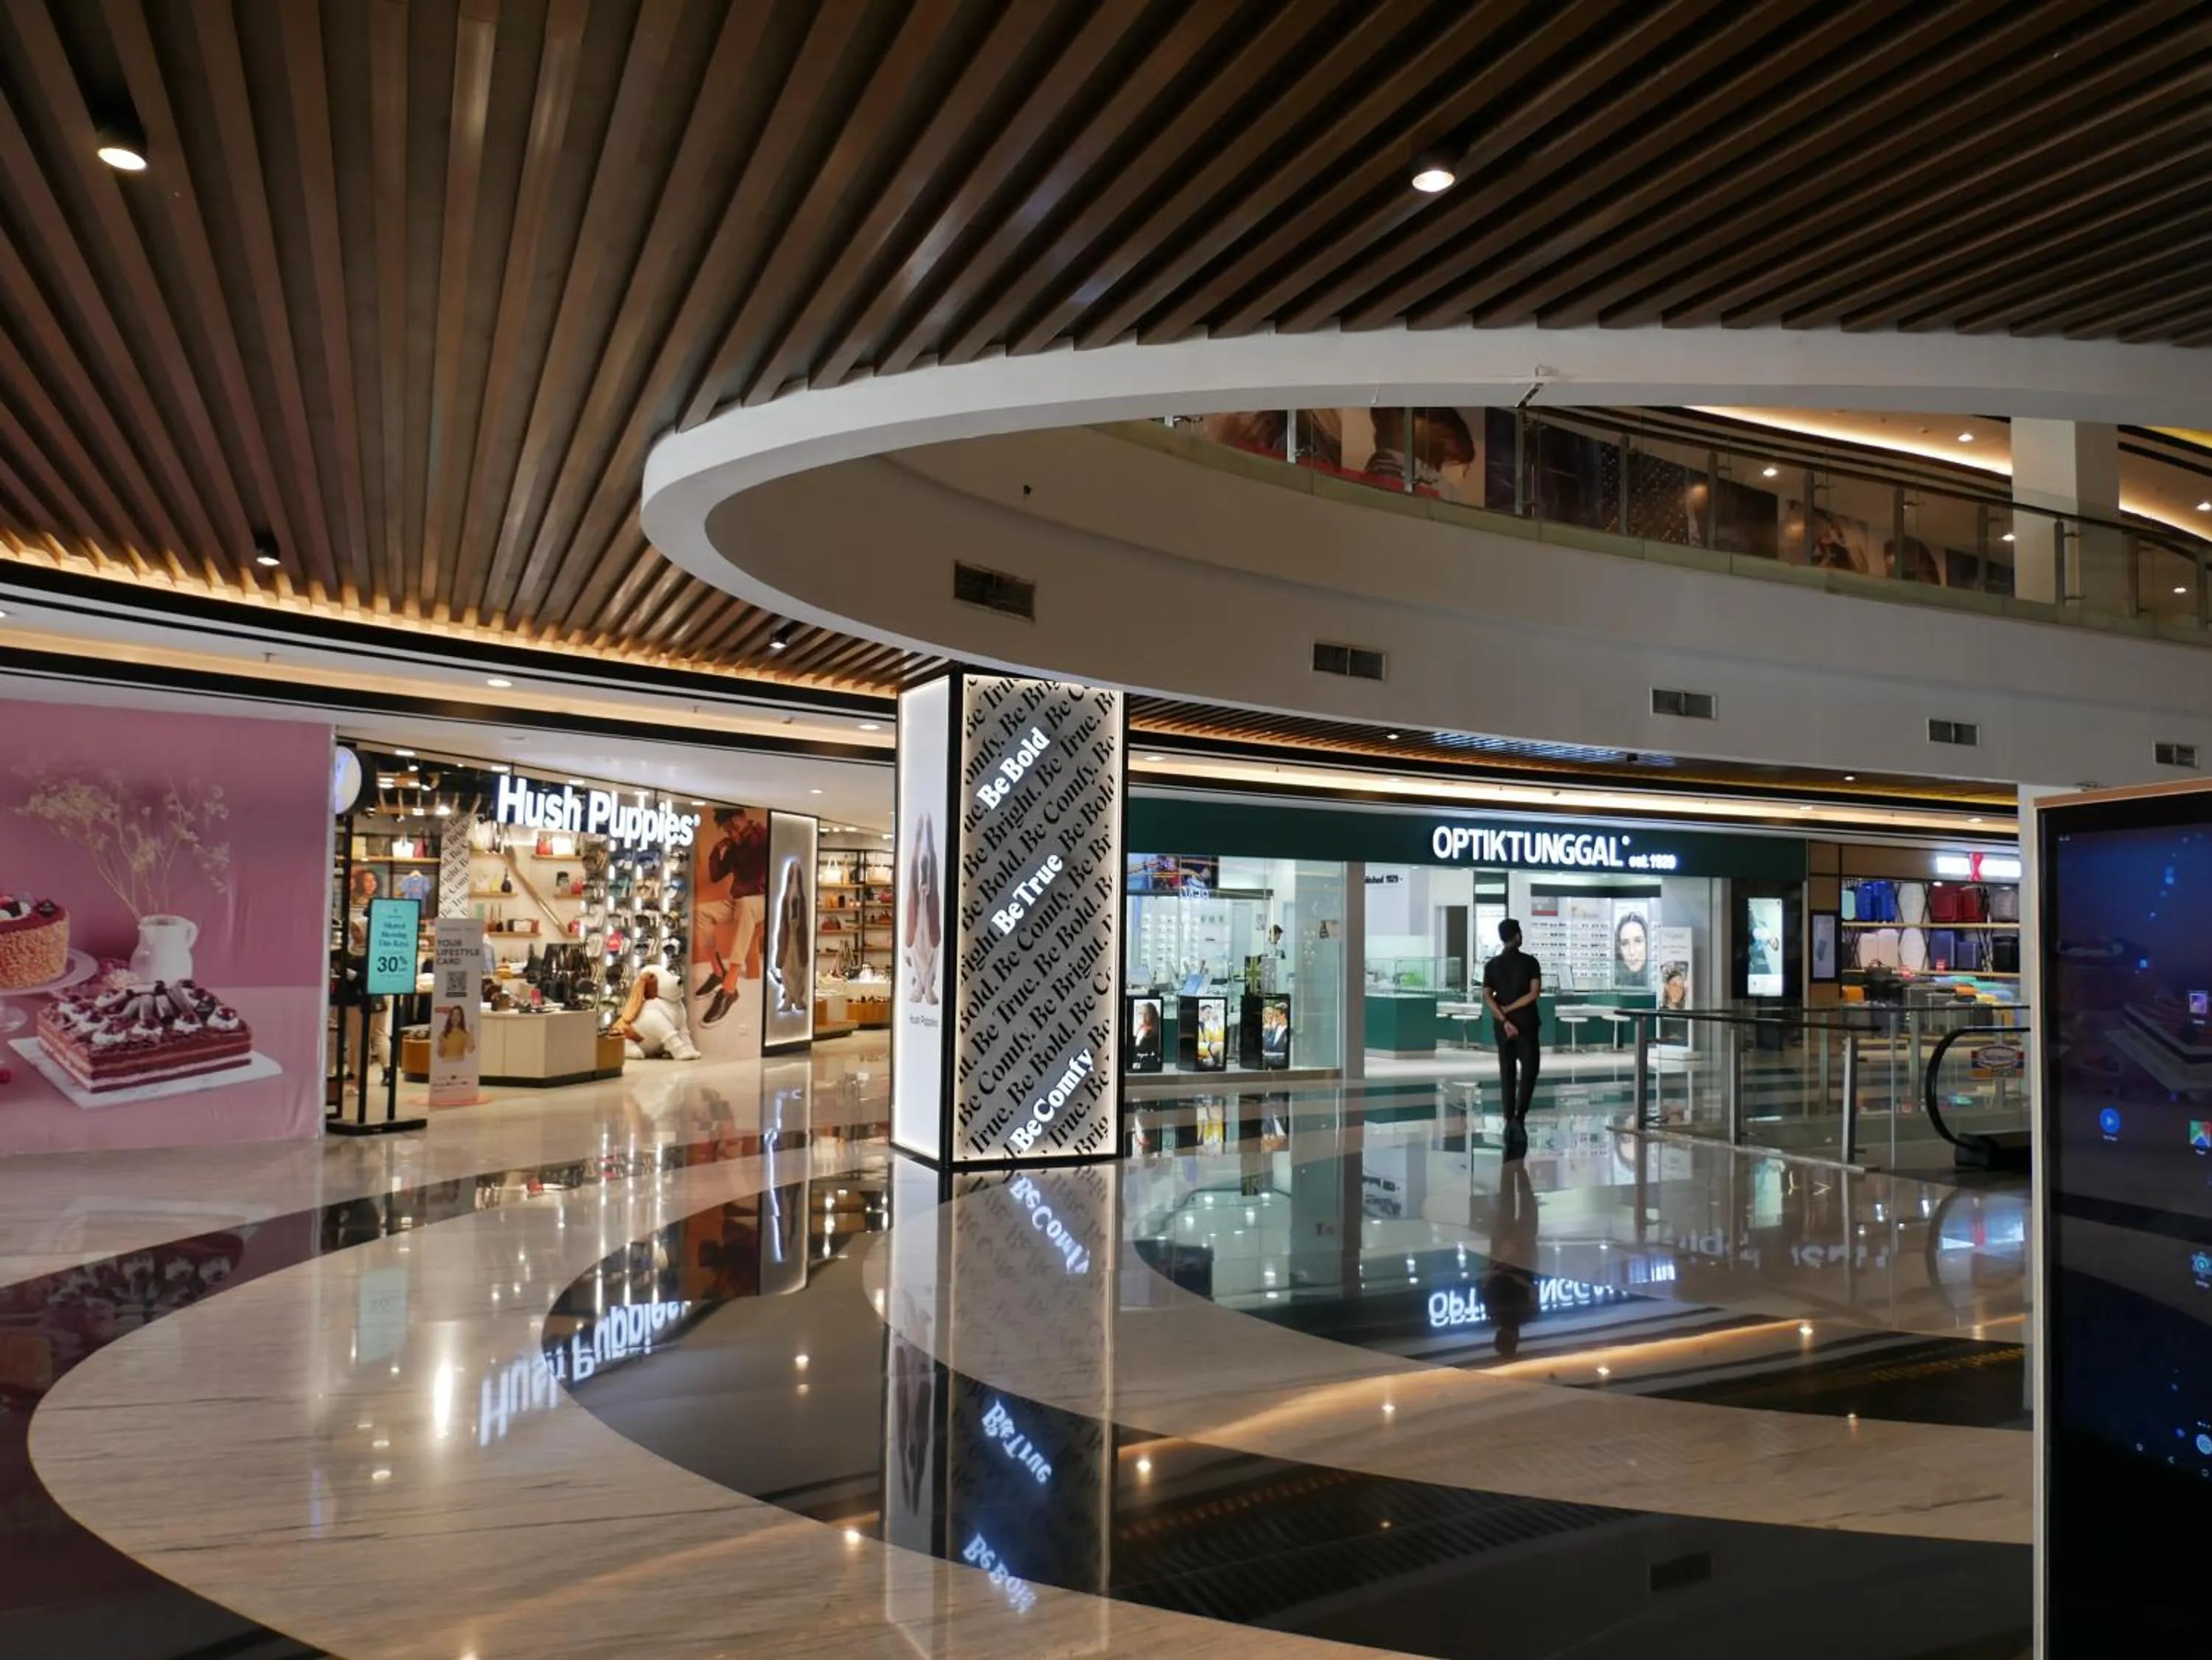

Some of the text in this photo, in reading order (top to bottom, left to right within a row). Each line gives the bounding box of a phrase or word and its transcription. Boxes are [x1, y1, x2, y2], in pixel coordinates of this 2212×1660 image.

[978, 678, 1020, 710] Tru
[999, 708, 1027, 738] Be
[975, 776, 1011, 810] Be
[1045, 700, 1071, 731] Be
[496, 775, 582, 833] Hush
[963, 854, 988, 879] Be
[1035, 757, 1062, 789] Be
[1019, 823, 1047, 854] Be
[991, 902, 1025, 935] Be
[1058, 822, 1085, 852] Be
[1432, 825, 1624, 868] OPTIKTUNGGAL
[992, 950, 1020, 982] Be
[1067, 859, 1093, 890] Be
[970, 1024, 999, 1056] Be
[1033, 946, 1062, 978] Be
[959, 1095, 981, 1128] Be
[1028, 998, 1057, 1030] Be
[1006, 1074, 1034, 1106] Be
[1069, 994, 1096, 1026] Be
[1084, 1070, 1110, 1102] Be
[1009, 1119, 1043, 1152] Be
